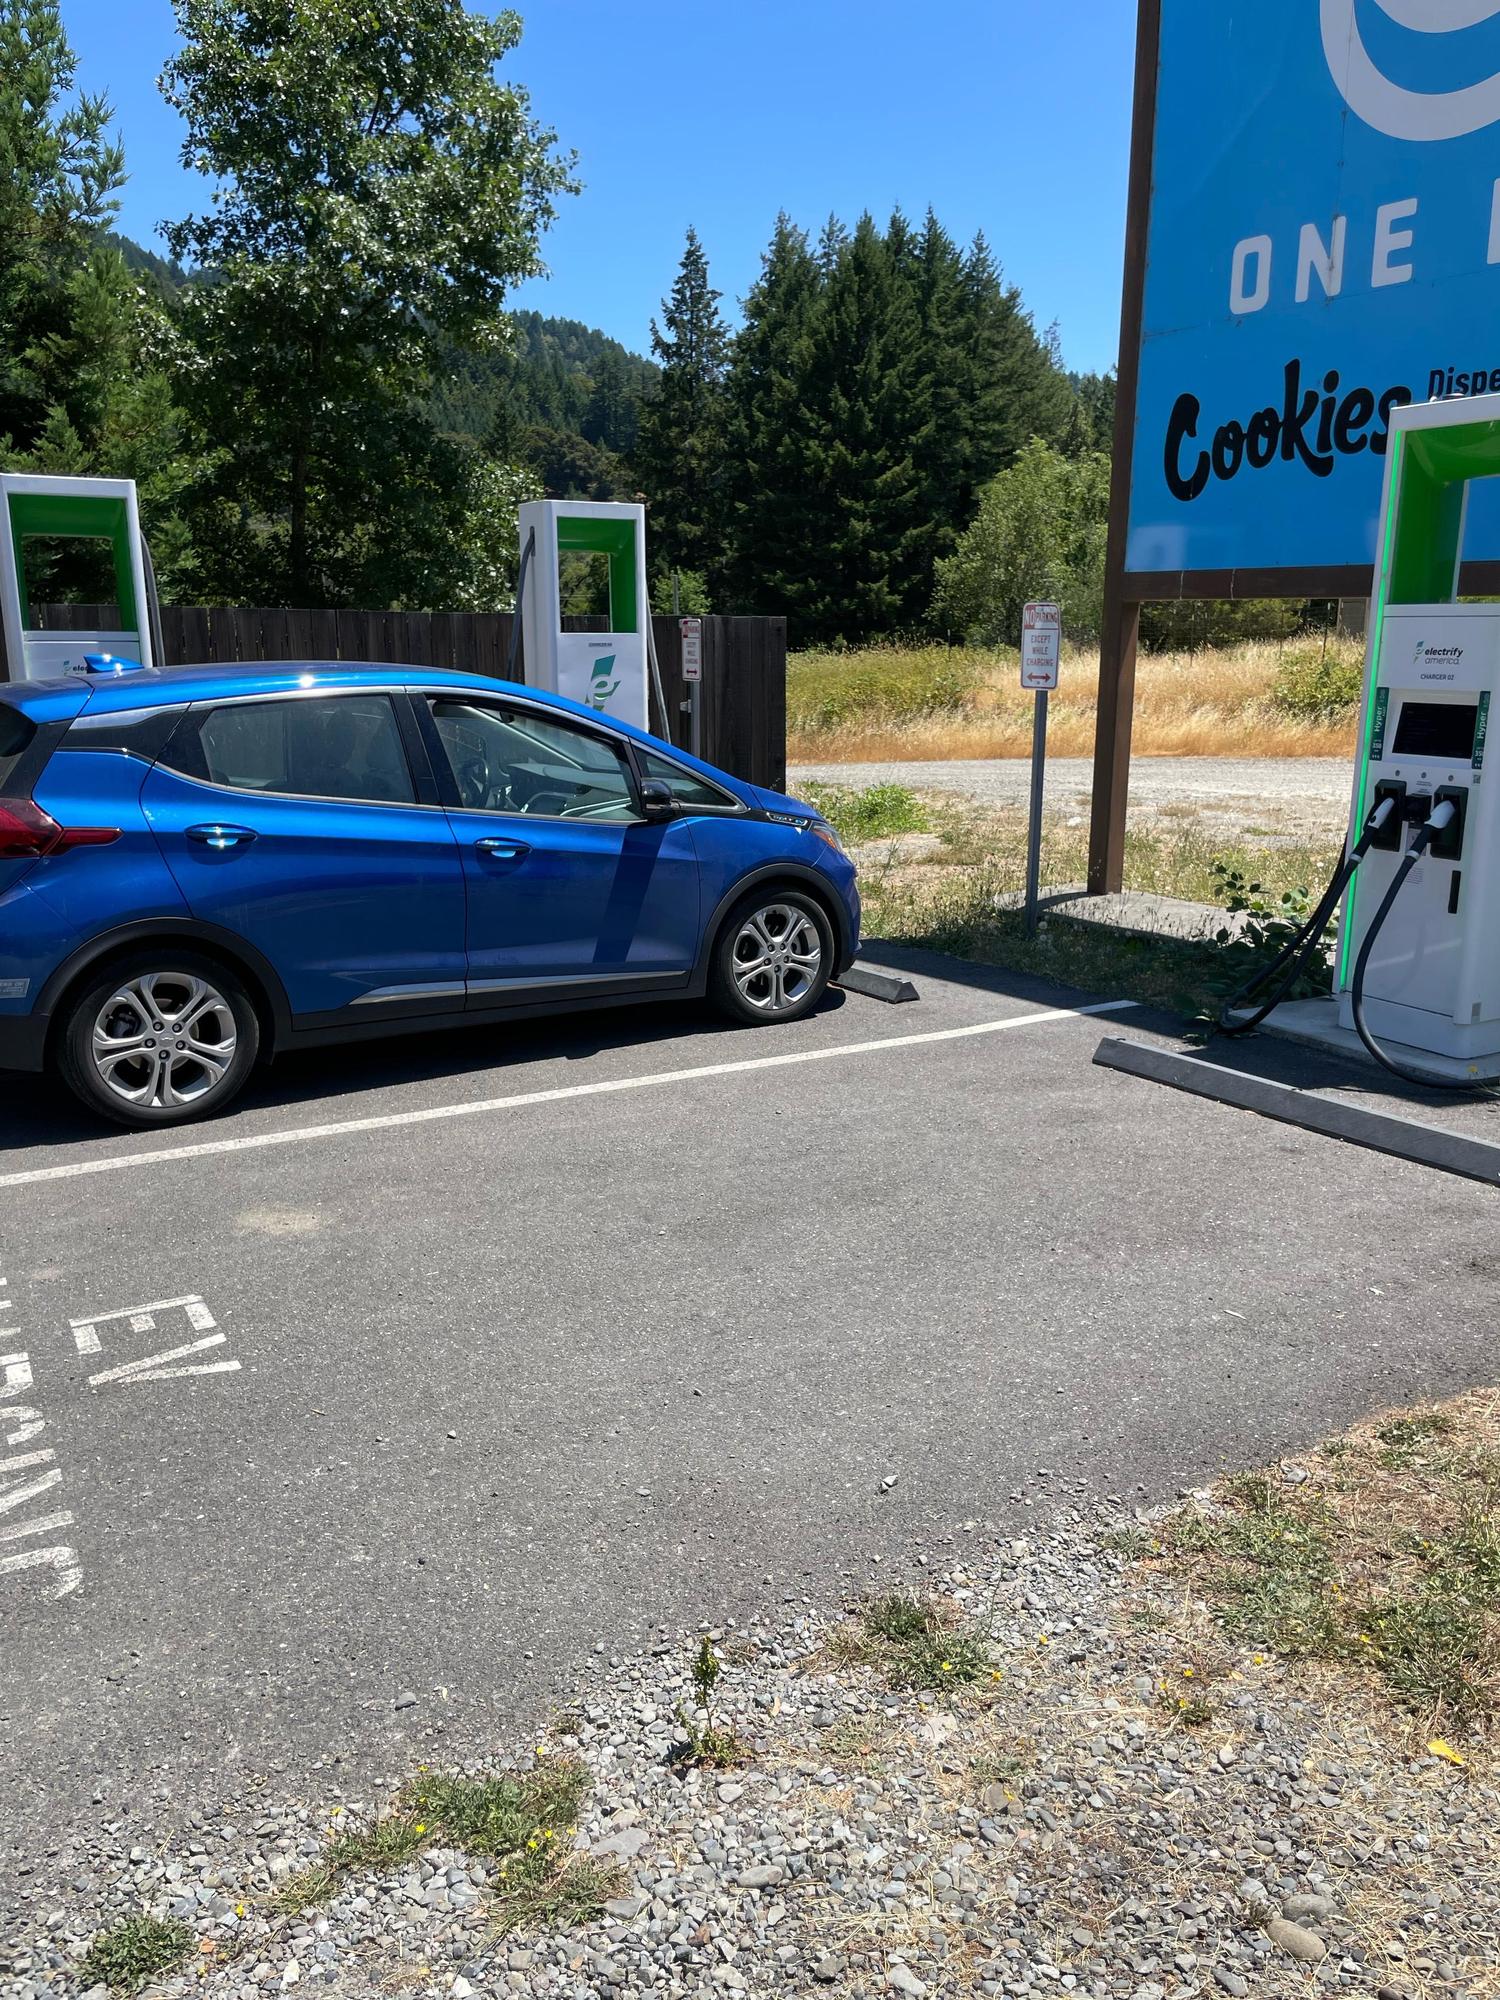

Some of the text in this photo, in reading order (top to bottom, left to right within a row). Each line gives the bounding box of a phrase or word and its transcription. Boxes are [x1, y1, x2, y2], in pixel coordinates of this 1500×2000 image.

[1229, 198, 1417, 315] ONE
[1164, 358, 1412, 502] Cookies
[1030, 634, 1051, 643] EXCEPT
[1032, 646, 1048, 655] WHILE
[1026, 658, 1054, 667] CHARGING
[1424, 647, 1464, 658] electrify
[1374, 707, 1383, 732] Hyper
[1477, 711, 1487, 739] Hyper
[68, 1294, 243, 1386] EV
